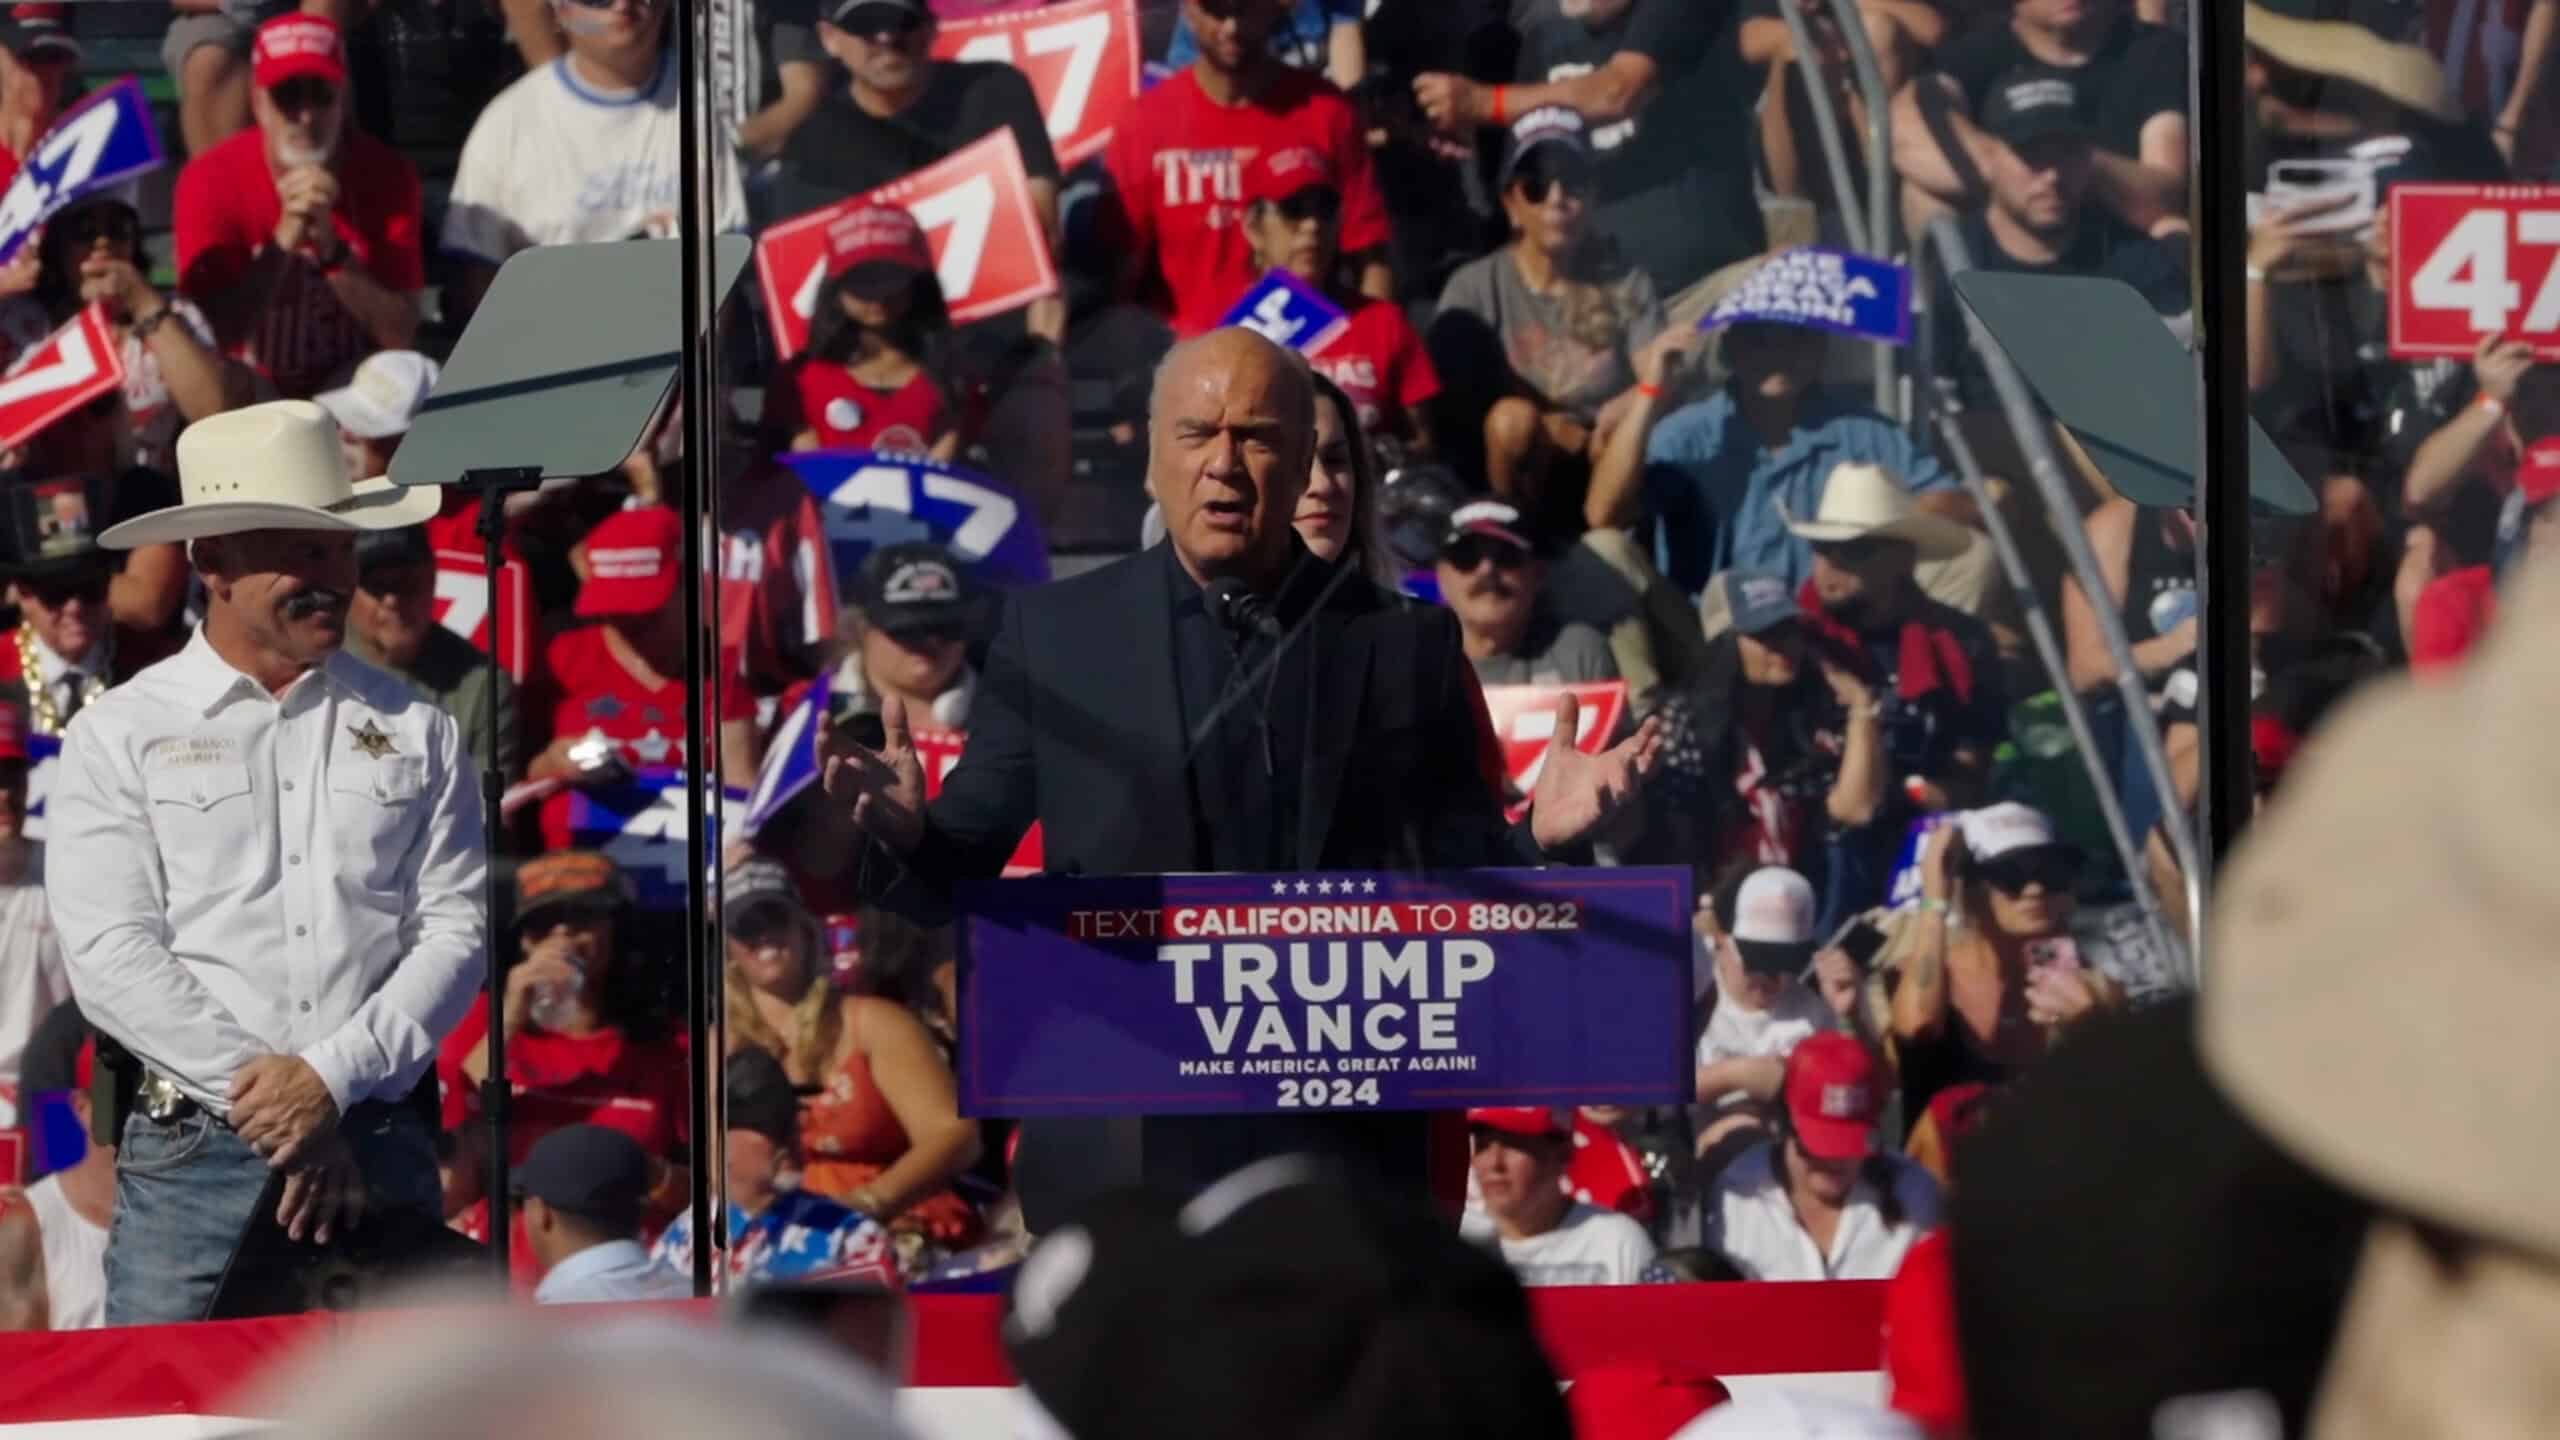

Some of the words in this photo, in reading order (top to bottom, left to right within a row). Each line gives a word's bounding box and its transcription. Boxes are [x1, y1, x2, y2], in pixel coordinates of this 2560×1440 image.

[791, 170, 996, 321] 7
[1072, 910, 1161, 938] TEXT
[1173, 904, 1400, 937] CALIFORNIA
[1408, 904, 1458, 932] TO
[1467, 903, 1579, 931] 88022
[1157, 939, 1496, 1004] TRUMP
[1195, 1002, 1458, 1055] VANCE
[1179, 1060, 1236, 1076] MAKE
[1241, 1058, 1331, 1075] AMERICA
[1337, 1057, 1401, 1073] GREAT
[1408, 1056, 1477, 1072] AGAIN!
[1277, 1078, 1381, 1108] 2024
